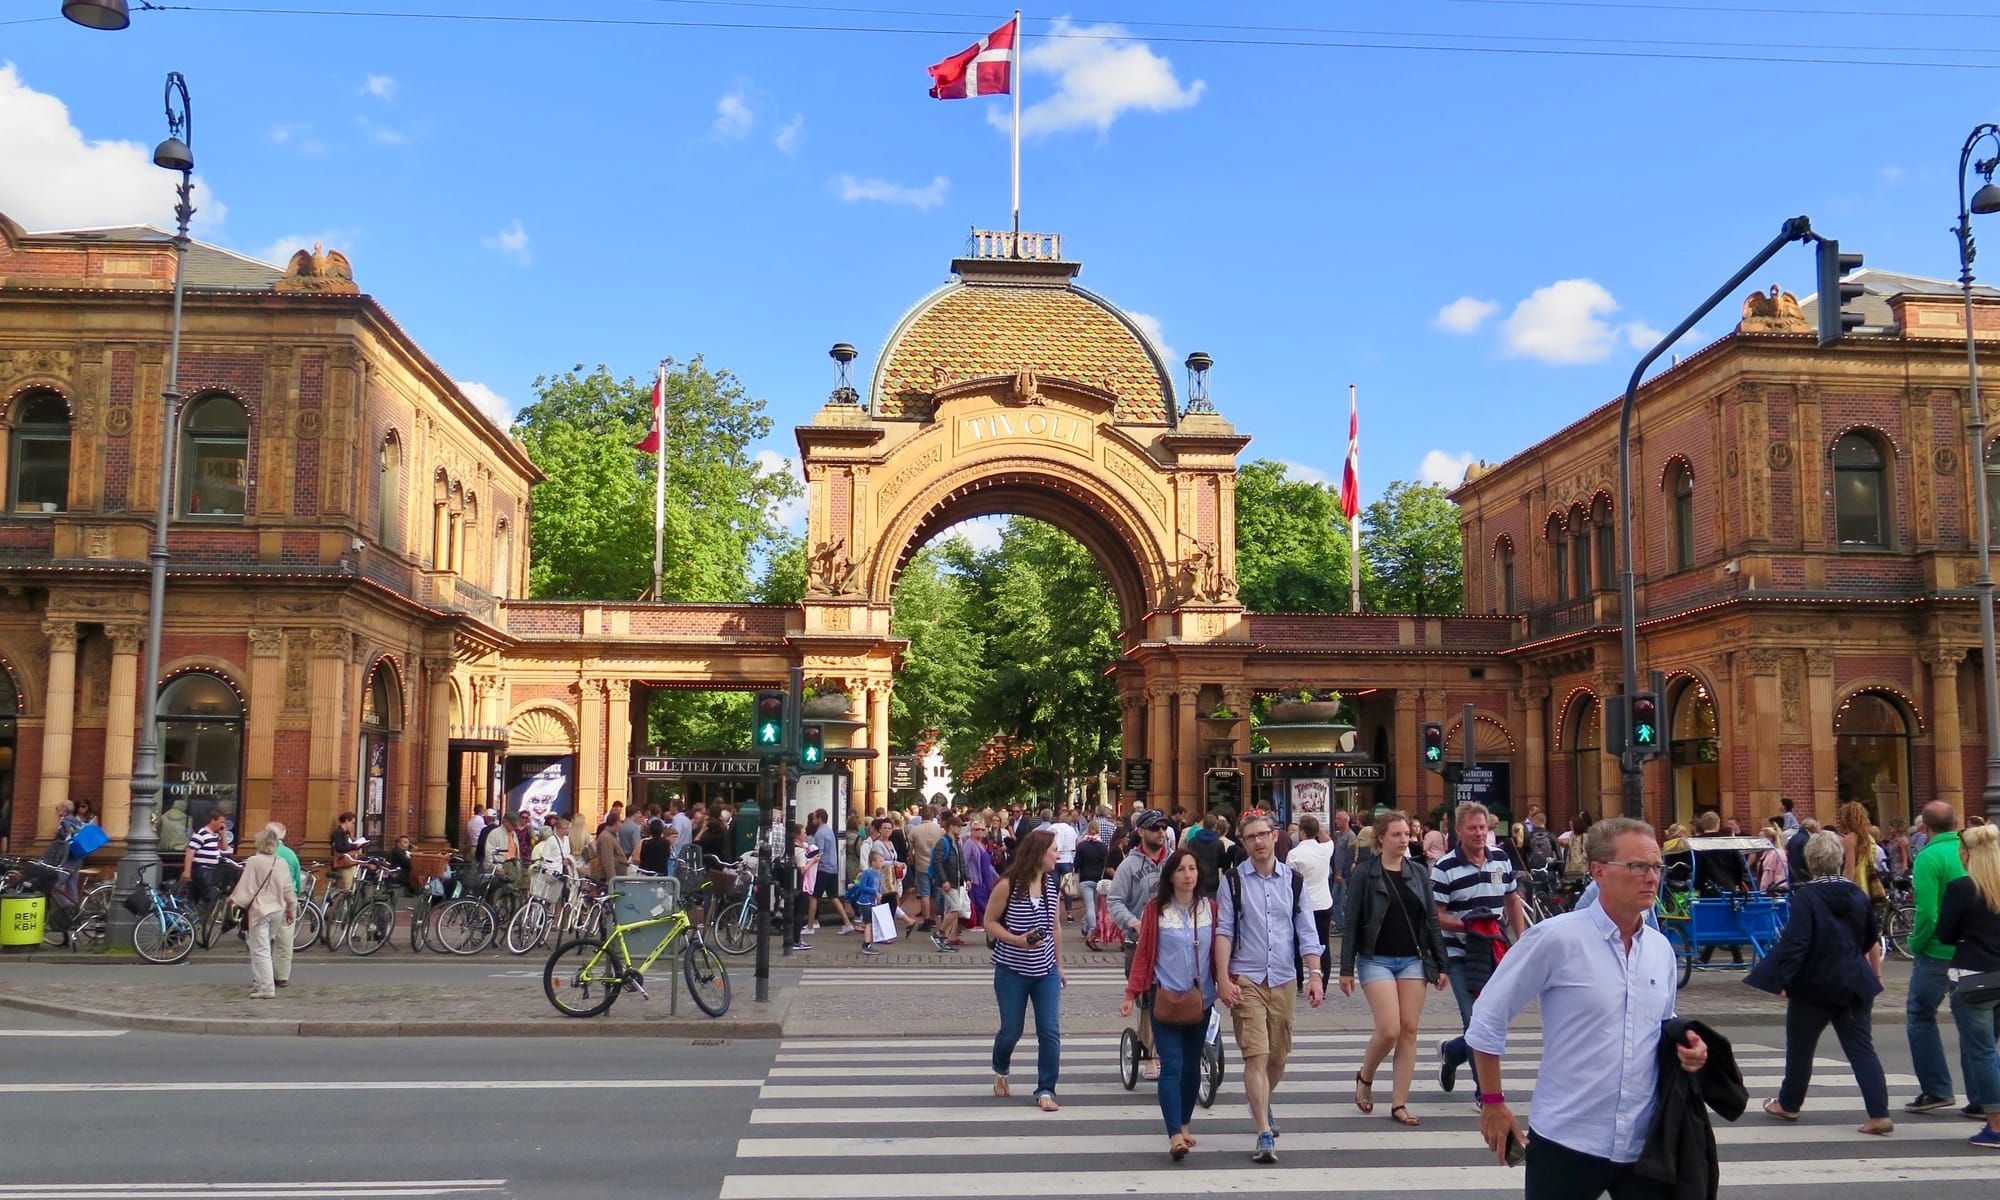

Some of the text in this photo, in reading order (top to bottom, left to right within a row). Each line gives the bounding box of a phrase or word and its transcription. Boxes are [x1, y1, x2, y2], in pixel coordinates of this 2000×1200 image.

[976, 230, 1057, 260] TIVOLI
[965, 412, 1079, 442] TIVOLI
[645, 761, 709, 773] BILLETTER
[711, 762, 718, 773] /
[1335, 767, 1379, 777] TICKETS
[181, 770, 208, 782] BOX
[170, 784, 218, 795] OFFICE
[15, 912, 37, 921] REN
[14, 922, 37, 931] KBH
